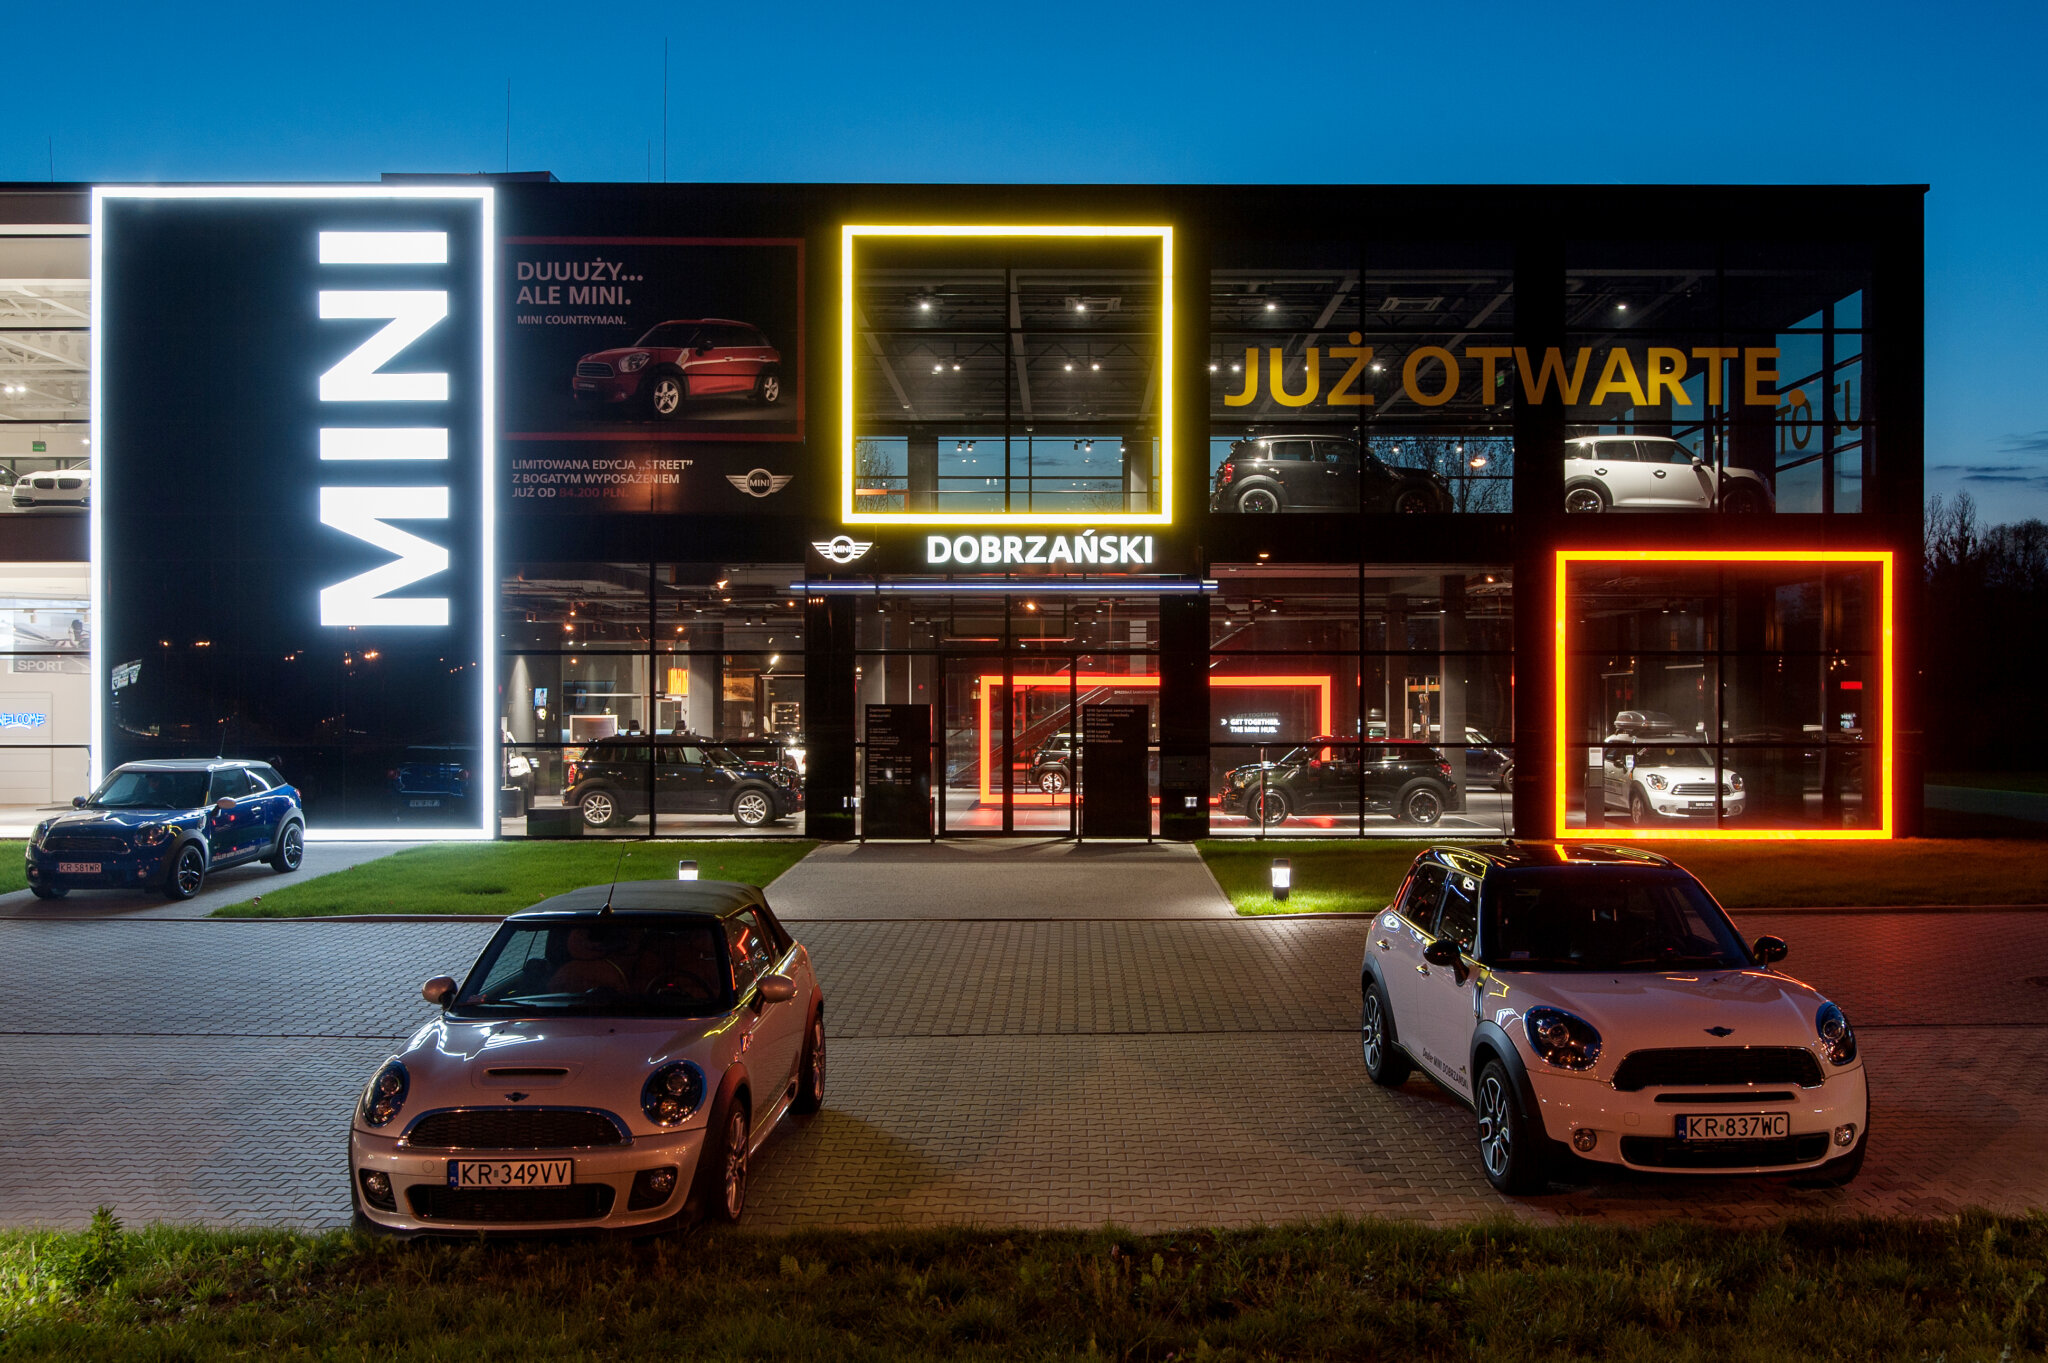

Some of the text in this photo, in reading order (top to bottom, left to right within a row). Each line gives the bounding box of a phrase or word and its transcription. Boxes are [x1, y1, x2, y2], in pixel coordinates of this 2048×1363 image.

[517, 257, 644, 281] DUUUŻY...
[516, 286, 632, 305] ALE MINI.
[517, 315, 627, 325] MINI COUNTRYMAN.
[1224, 331, 1375, 407] JUŻ
[1403, 346, 1806, 407] OTWARTE.
[319, 231, 450, 629] MINI
[512, 459, 589, 470] LIMITOWANA
[592, 459, 636, 470] EDYCJA
[512, 472, 680, 484] Z BOGATYM WYPOSAŻENIEM
[749, 479, 770, 487] MINI
[512, 486, 535, 498] JUŻ
[537, 488, 556, 498] OD
[832, 545, 852, 553] MINI
[928, 529, 1153, 564] DOBRZAŃSKI
[17, 660, 65, 672] SPORT
[1690, 1116, 1785, 1137] KR 837WC
[462, 1162, 567, 1184] KR 349VV
